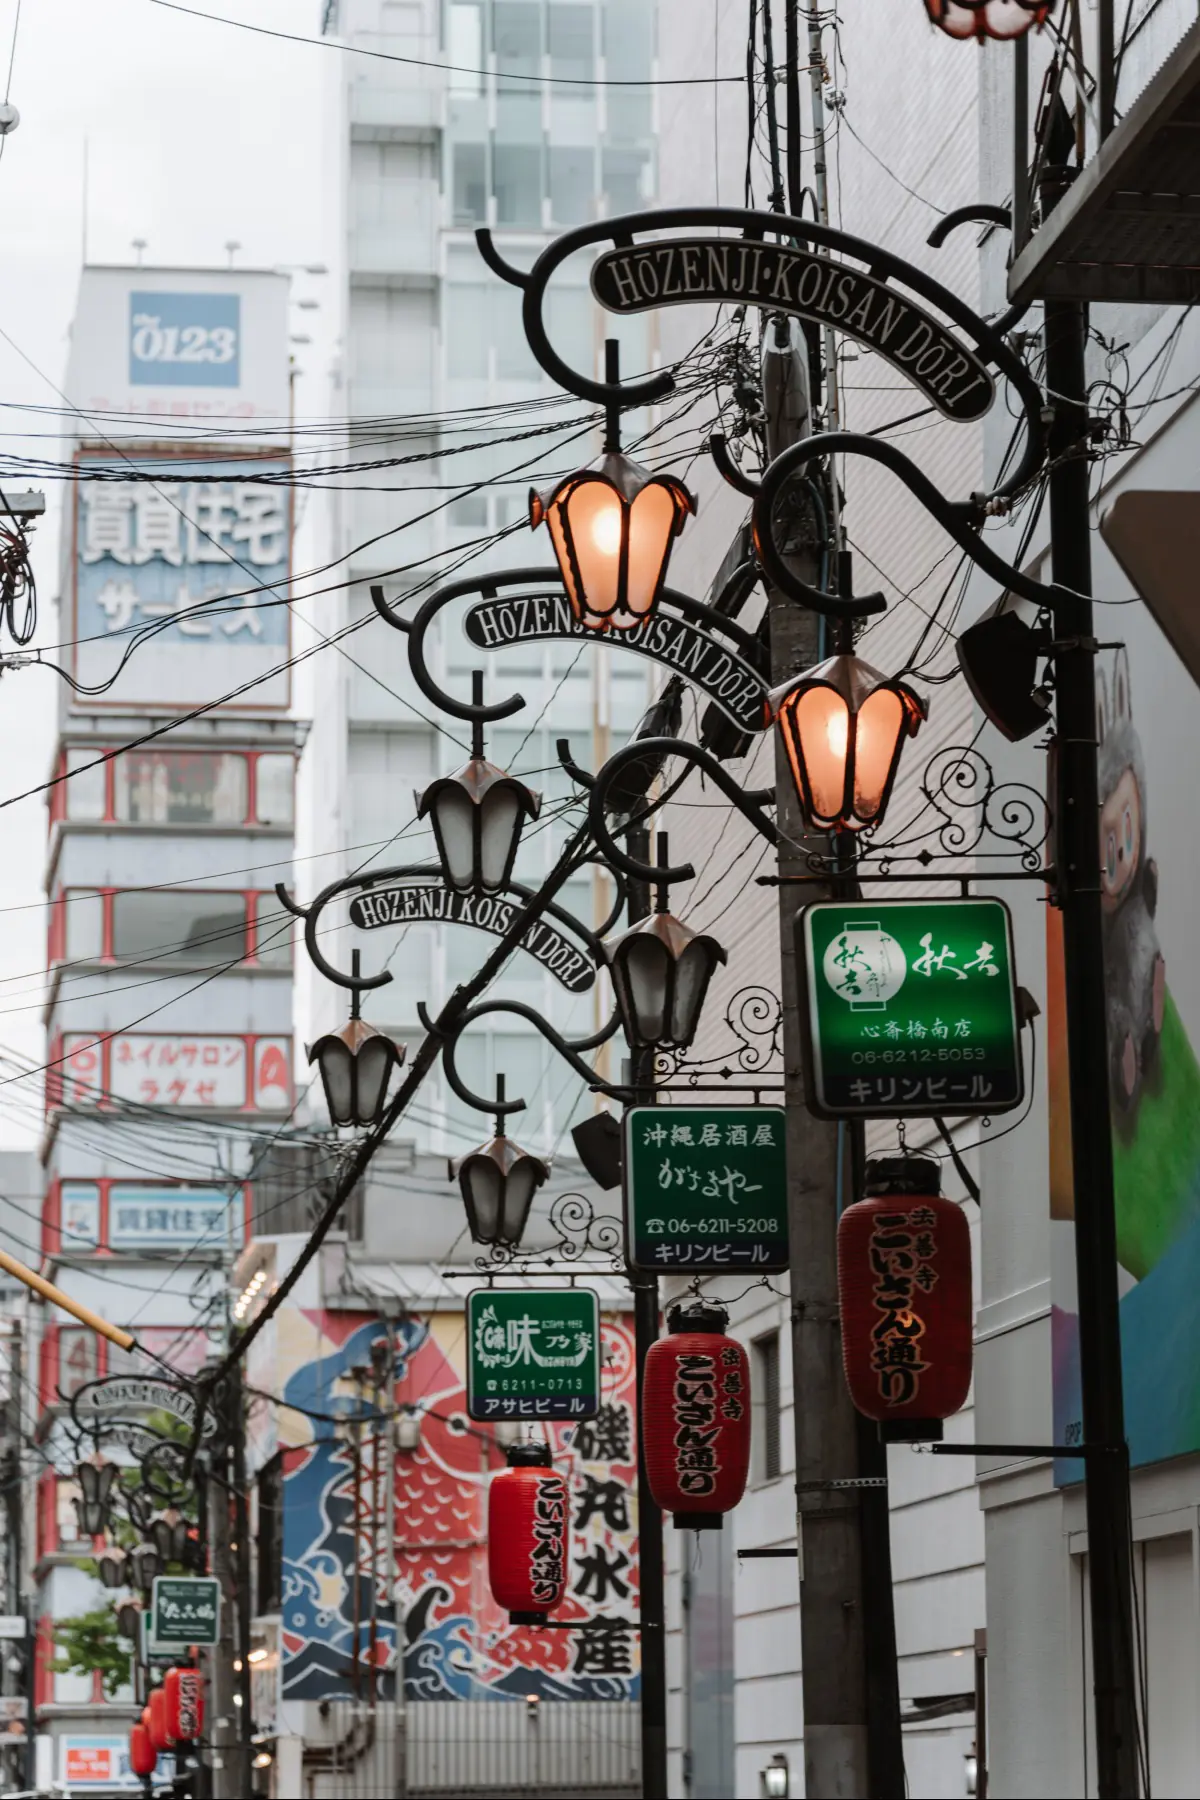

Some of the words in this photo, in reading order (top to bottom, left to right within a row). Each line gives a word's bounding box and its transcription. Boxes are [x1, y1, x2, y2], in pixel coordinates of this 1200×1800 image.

[133, 325, 235, 364] 0123
[894, 320, 988, 407] DŌRI
[97, 575, 261, 636] サービス
[357, 887, 454, 928] HŌZENJI
[535, 934, 593, 988] DŌRI
[912, 932, 1000, 980] 秋吉
[116, 1040, 242, 1067] ネイルサロン
[851, 1048, 986, 1065] 06-6212-5053
[849, 1076, 992, 1102] キリンビール
[642, 1123, 776, 1148] 沖縄居酒屋
[667, 1218, 779, 1233] 06-6211-5208
[655, 1244, 770, 1262] キリンビール
[870, 1213, 933, 1407] こいさん通り
[502, 1378, 583, 1391] 6211-0713
[720, 1347, 744, 1421] 法善寺
[485, 1398, 585, 1414] アサヒビール
[672, 1355, 724, 1496] こいさん通り
[529, 1477, 565, 1603] こいさん通り
[573, 1402, 633, 1676] 磯丸水産
